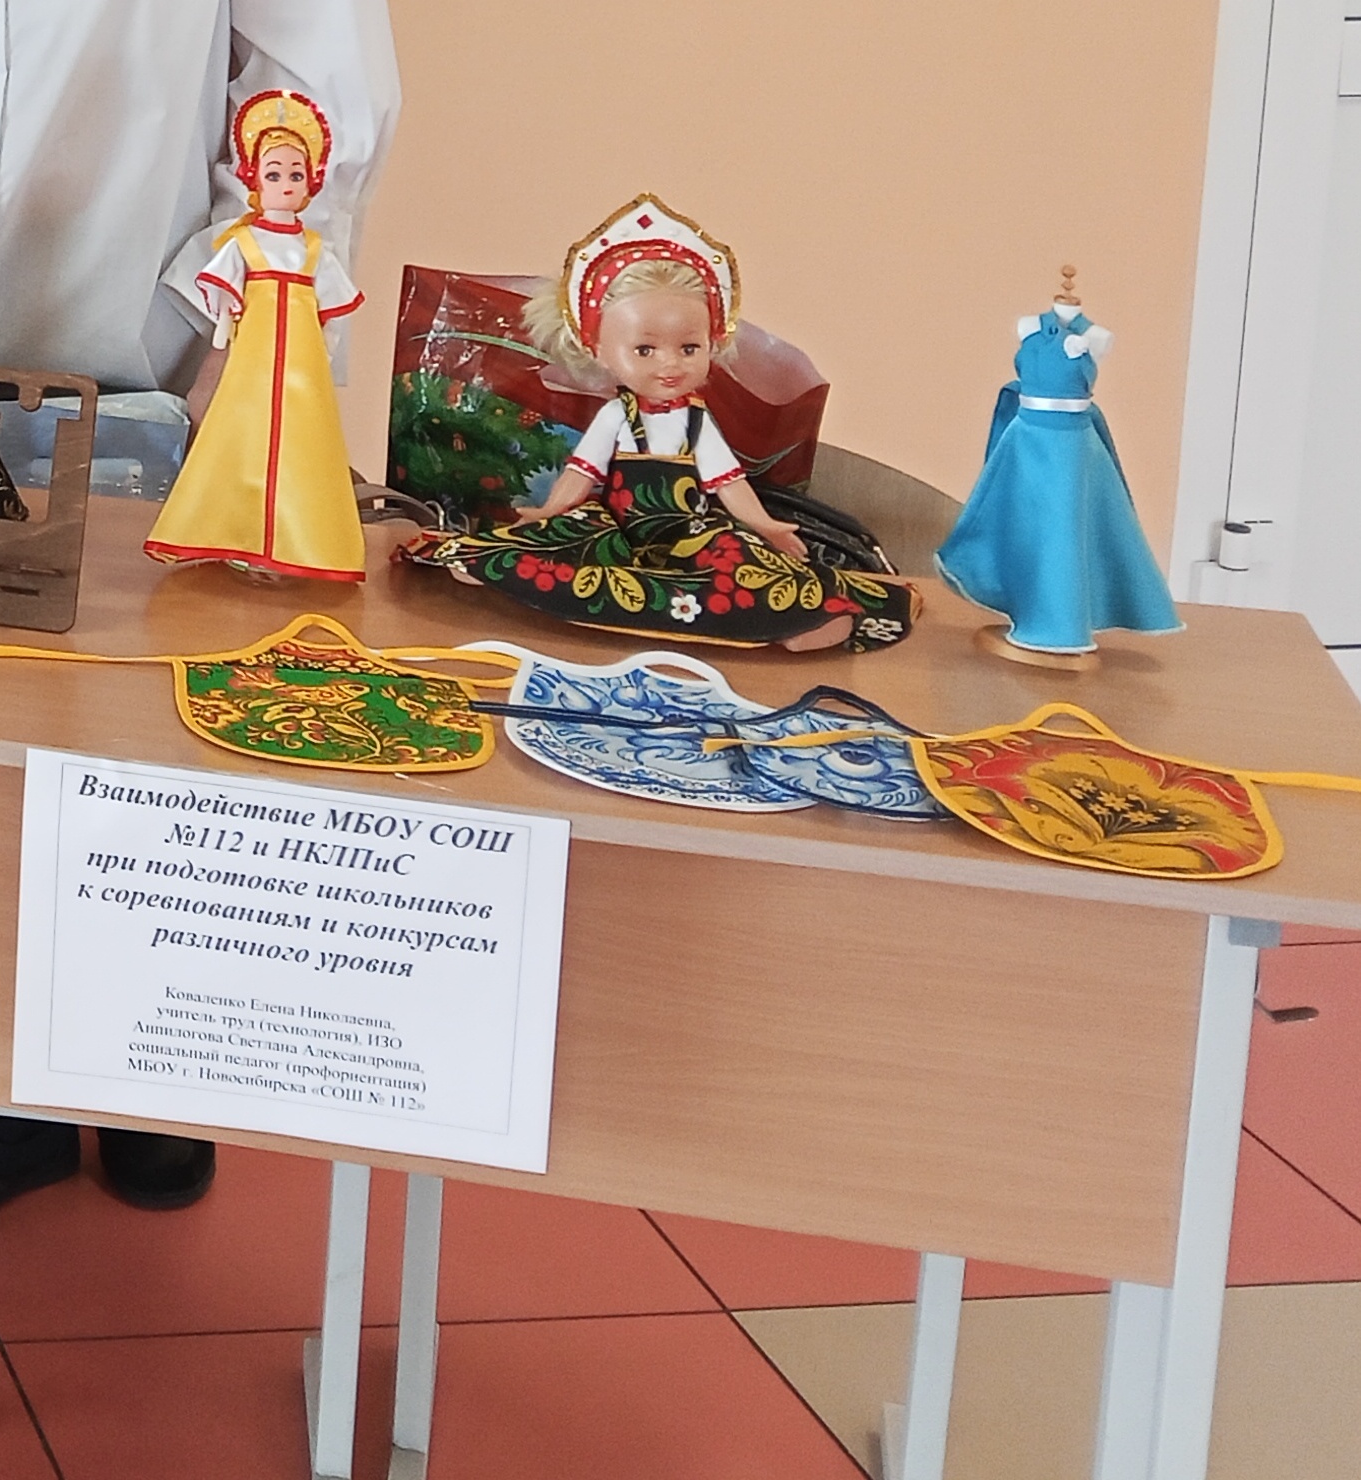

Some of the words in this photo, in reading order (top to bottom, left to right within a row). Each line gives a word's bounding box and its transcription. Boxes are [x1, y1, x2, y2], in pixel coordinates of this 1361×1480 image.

[78, 773, 316, 827] Взаимодействие
[323, 808, 423, 841] МБОУ
[429, 823, 515, 853] СОШ
[164, 822, 245, 854] №112
[252, 839, 269, 857] и
[278, 837, 416, 876] НКЛПиС
[86, 851, 137, 874] при
[145, 859, 309, 896] подготовке
[316, 883, 494, 920] школьников
[77, 883, 95, 899] к
[101, 887, 312, 930] соревнованиям
[321, 917, 339, 934] и
[346, 921, 498, 955] конкурсам
[150, 926, 311, 964] различного
[314, 950, 414, 978] уровня
[156, 1006, 217, 1023] учитель
[221, 1015, 255, 1031] труд
[367, 1033, 403, 1050] ИЗО
[165, 986, 246, 1009] Коваленко
[250, 998, 295, 1016] Елена
[300, 1004, 396, 1032] Николаевна,
[128, 1041, 220, 1063] социальный
[224, 1053, 283, 1072] педагог
[285, 1060, 427, 1094] (профориентация)
[128, 1057, 178, 1076] МБОУ
[198, 1066, 306, 1094] Новосибирска
[228, 1032, 298, 1055] Светлана
[303, 1044, 425, 1074] Александровна,
